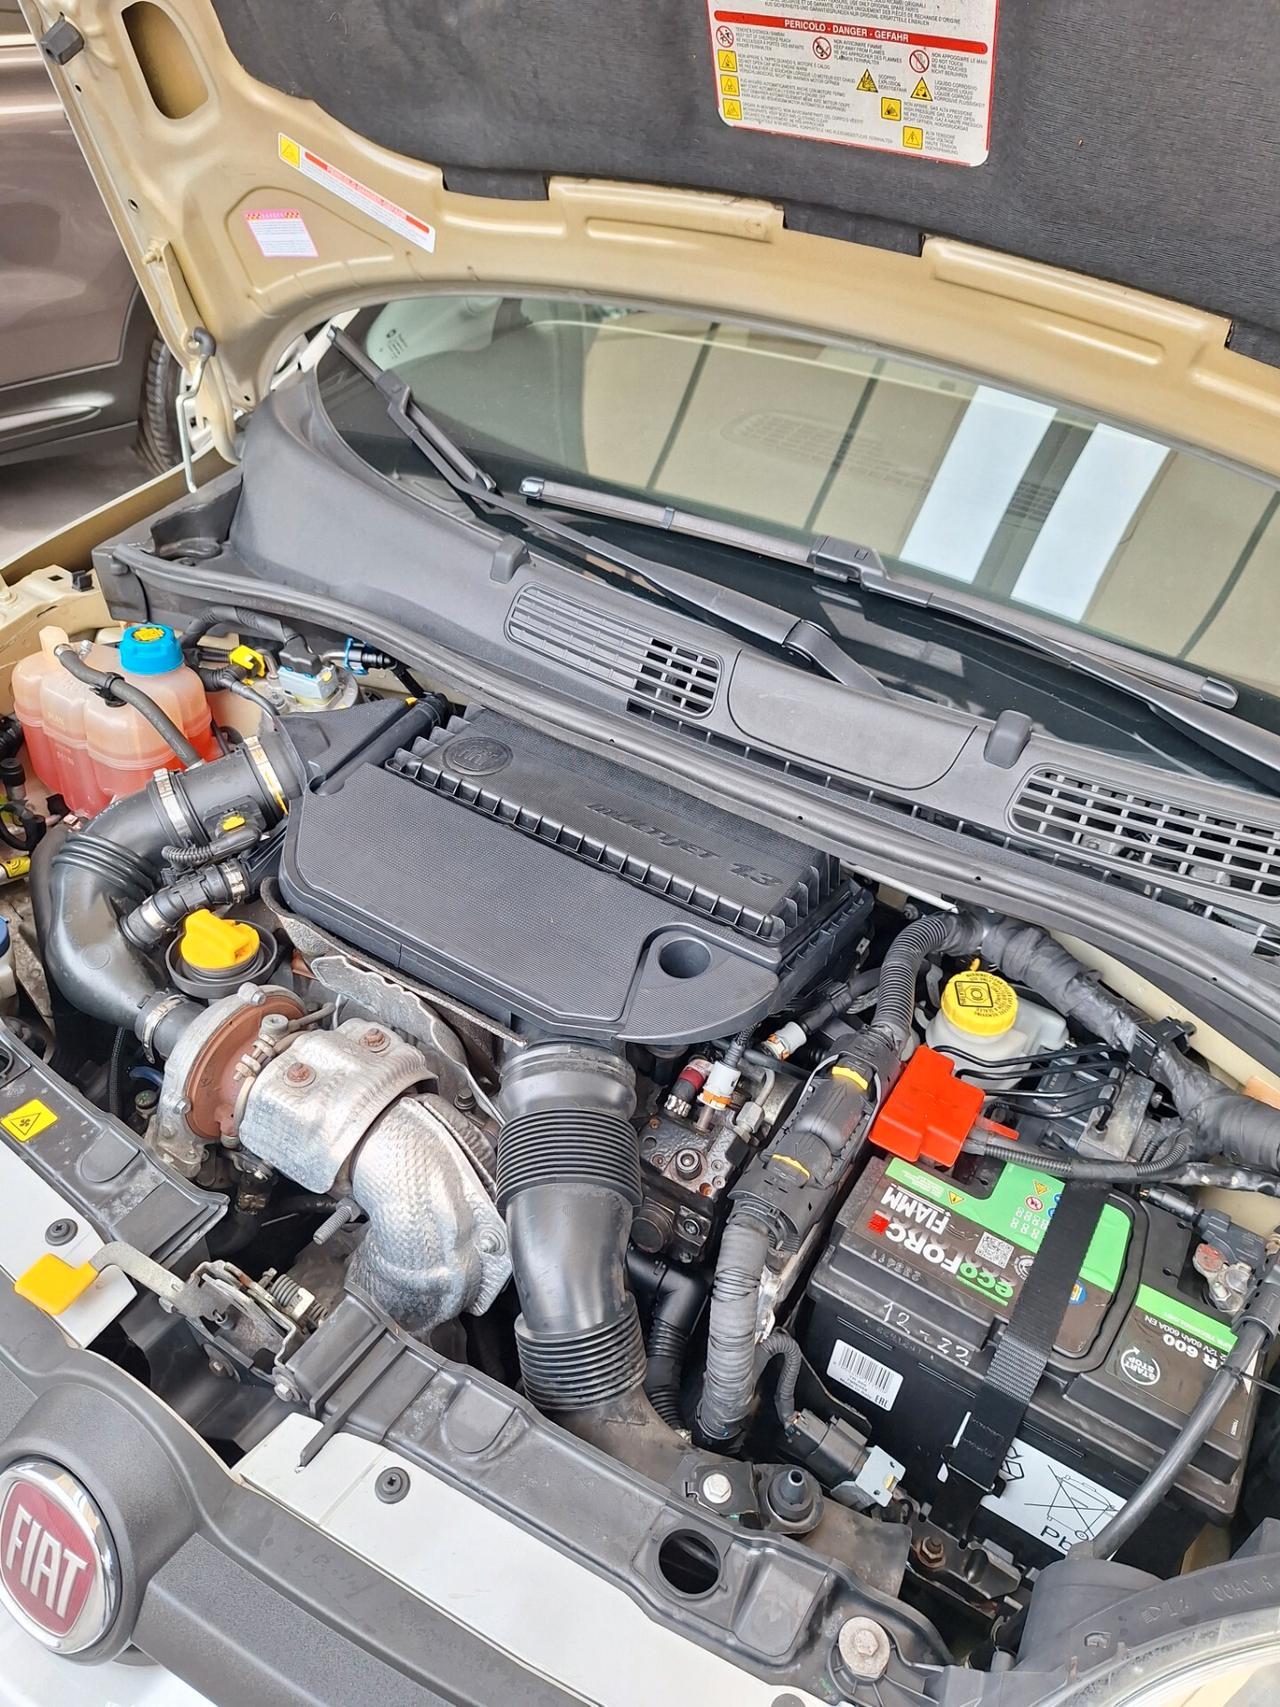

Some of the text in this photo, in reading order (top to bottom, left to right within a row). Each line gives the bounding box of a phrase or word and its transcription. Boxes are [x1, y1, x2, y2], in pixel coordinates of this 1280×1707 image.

[784, 19, 826, 31] PERICOLO
[833, 25, 867, 36] DANGER
[874, 31, 909, 42] GEFAHR
[881, 1187, 950, 1235] FIAMM
[1144, 1315, 1158, 1326] EN
[1159, 1323, 1180, 1337] 600A
[1163, 1334, 1198, 1358] 600
[1181, 1334, 1202, 1348] 60Ah
[1203, 1344, 1218, 1356] 12V
[1124, 1360, 1155, 1381] START
[1128, 1357, 1155, 1372] STOP
[1040, 1525, 1072, 1551] Pb
[4, 1504, 88, 1618] FIAT
